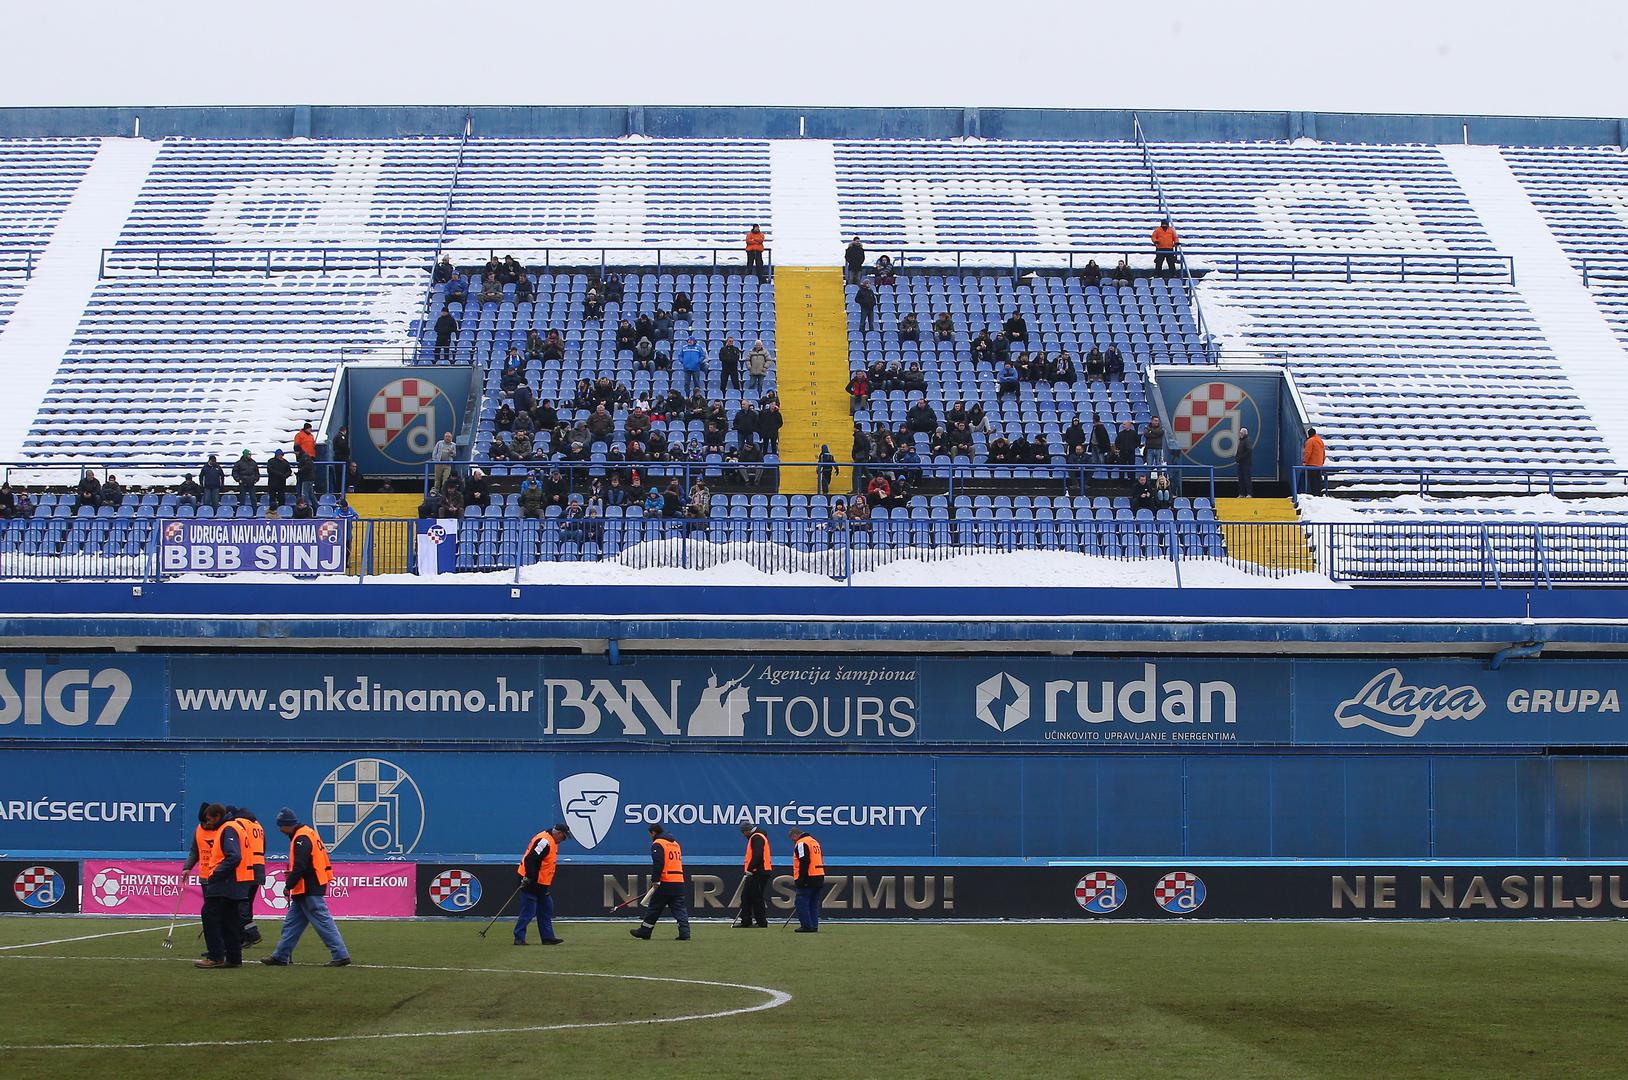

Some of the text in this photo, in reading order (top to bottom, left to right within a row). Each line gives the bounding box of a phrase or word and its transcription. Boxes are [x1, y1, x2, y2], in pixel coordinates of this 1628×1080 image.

[190, 521, 317, 544] UDRUGA NAVIJAČA DINAMA
[164, 545, 341, 570] BBB SINJ
[758, 664, 916, 686] Agencija šampiona
[175, 676, 534, 720] www.gnkdinamo.hr
[1044, 662, 1236, 724] rudan
[1506, 688, 1621, 714] GRUPA
[544, 678, 682, 735] BAN
[756, 696, 916, 738] TOURS
[1044, 730, 1236, 740] UČINKOVITO UPRAVLJANJE ENERGENTIMA
[624, 800, 928, 826] SOKOLMARIĆSECURITY
[120, 875, 178, 886] HRVATSKI
[120, 886, 179, 896] PRVA LIGA
[352, 876, 408, 886] TELEKOM
[1332, 876, 1628, 909] NE NASILJU
